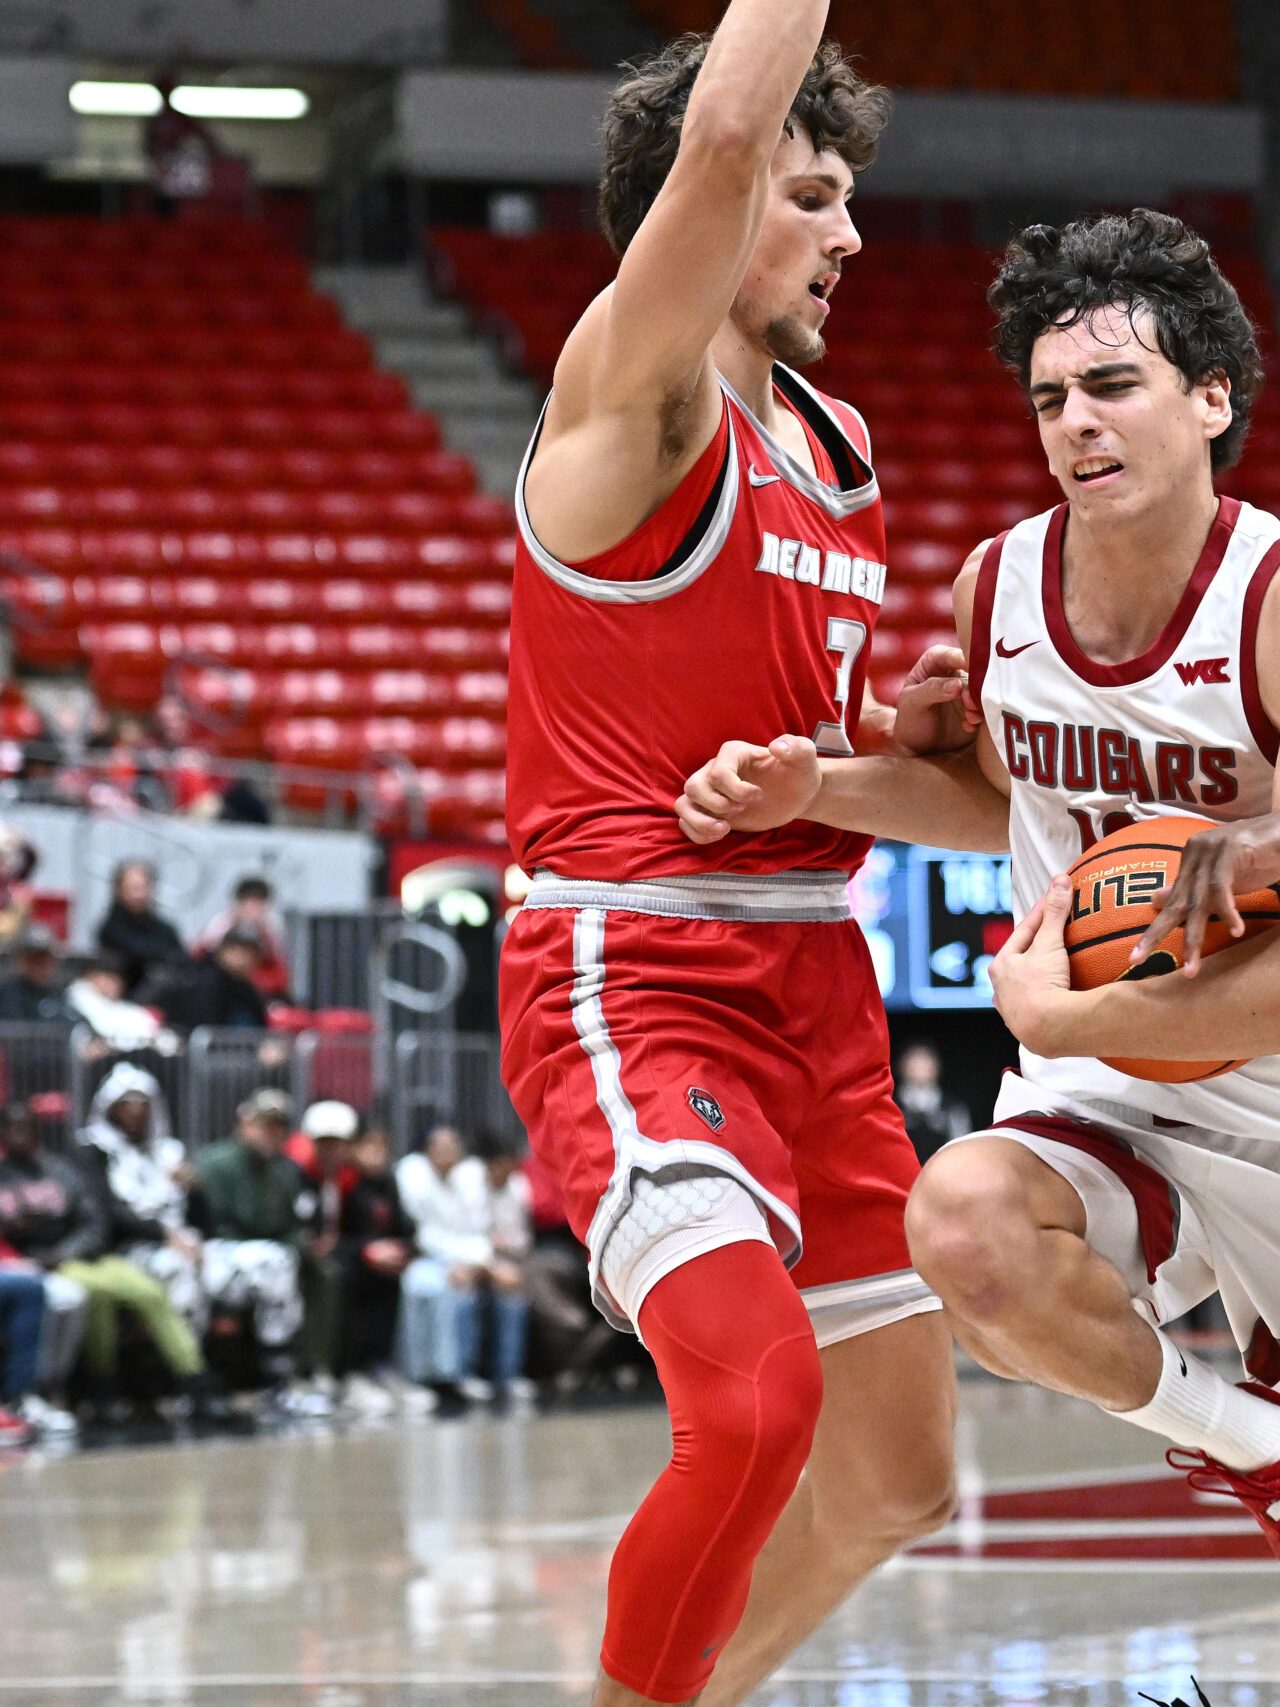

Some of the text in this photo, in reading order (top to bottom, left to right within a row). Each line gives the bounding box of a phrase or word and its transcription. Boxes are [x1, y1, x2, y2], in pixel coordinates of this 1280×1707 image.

[755, 531, 820, 587] NEW
[1173, 657, 1231, 687] WCC
[1001, 709, 1239, 806] COUGARS
